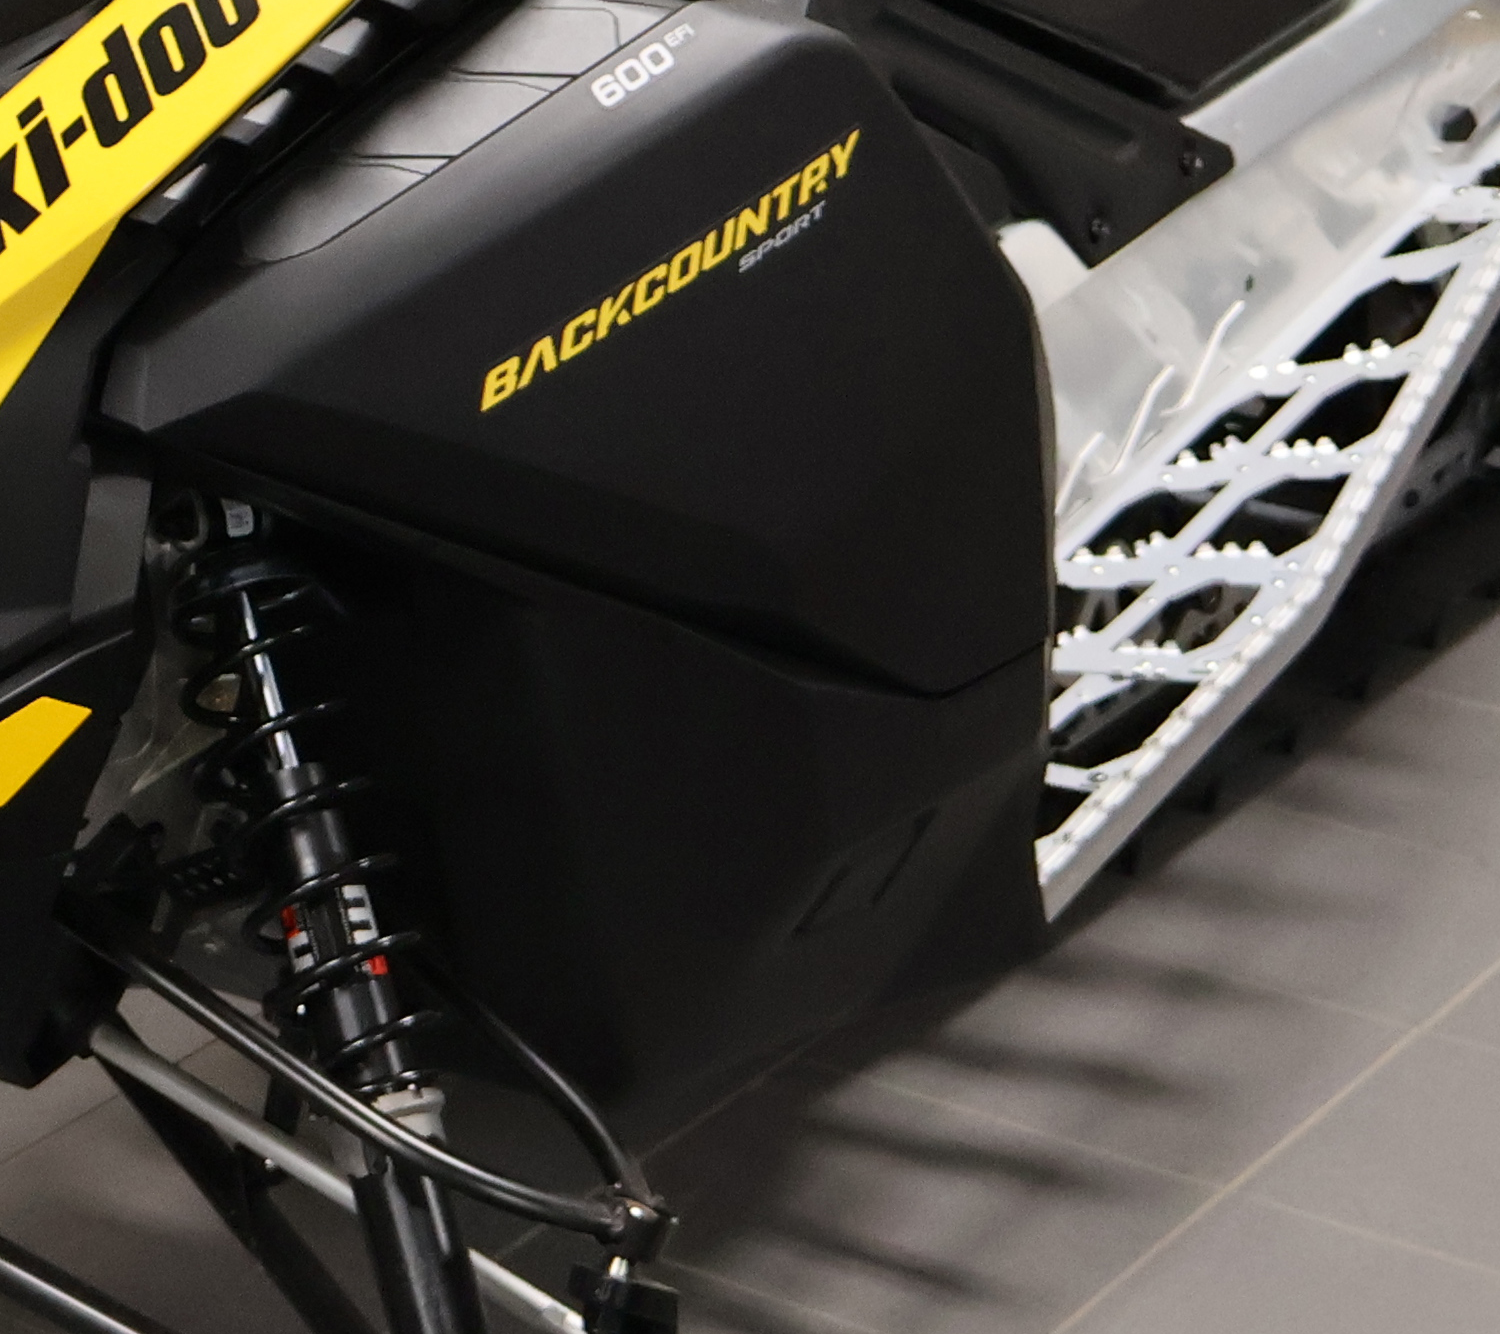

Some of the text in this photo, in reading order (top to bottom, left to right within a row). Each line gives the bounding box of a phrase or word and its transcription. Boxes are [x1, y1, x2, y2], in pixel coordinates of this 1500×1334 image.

[590, 23, 695, 108] 600 EFI
[480, 127, 862, 412] BACKCOUNTRY
[738, 199, 826, 273] SPORT
